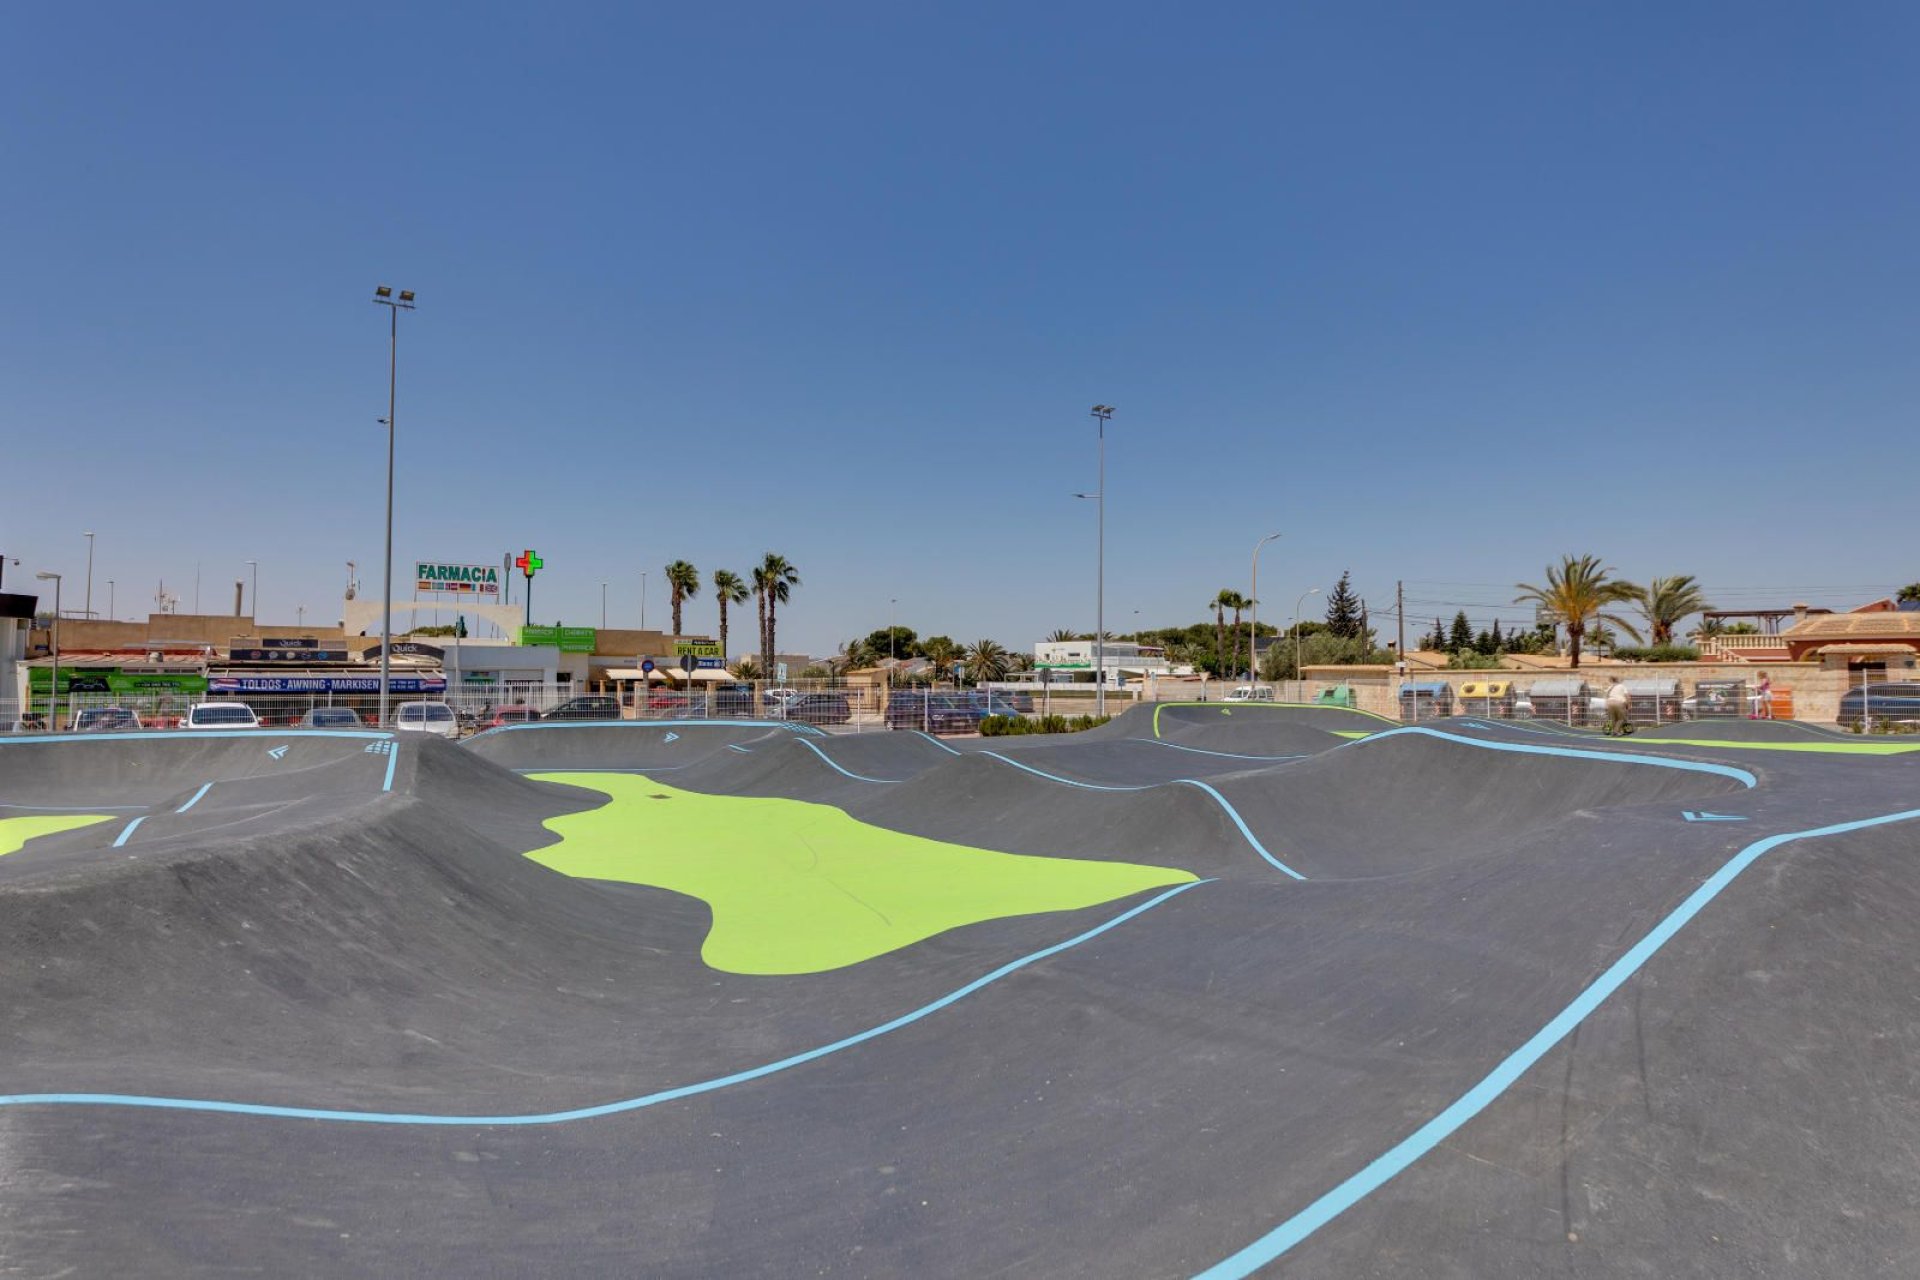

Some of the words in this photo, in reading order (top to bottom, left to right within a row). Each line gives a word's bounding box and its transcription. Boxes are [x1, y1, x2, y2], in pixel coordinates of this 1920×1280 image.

[418, 564, 498, 583] FARMACIA
[392, 644, 417, 653] Quick
[677, 646, 698, 655] RENT
[704, 647, 719, 656] CAR
[242, 679, 281, 690] TOLDOS
[286, 679, 326, 690] AWNING
[331, 679, 379, 690] MARKISEN
